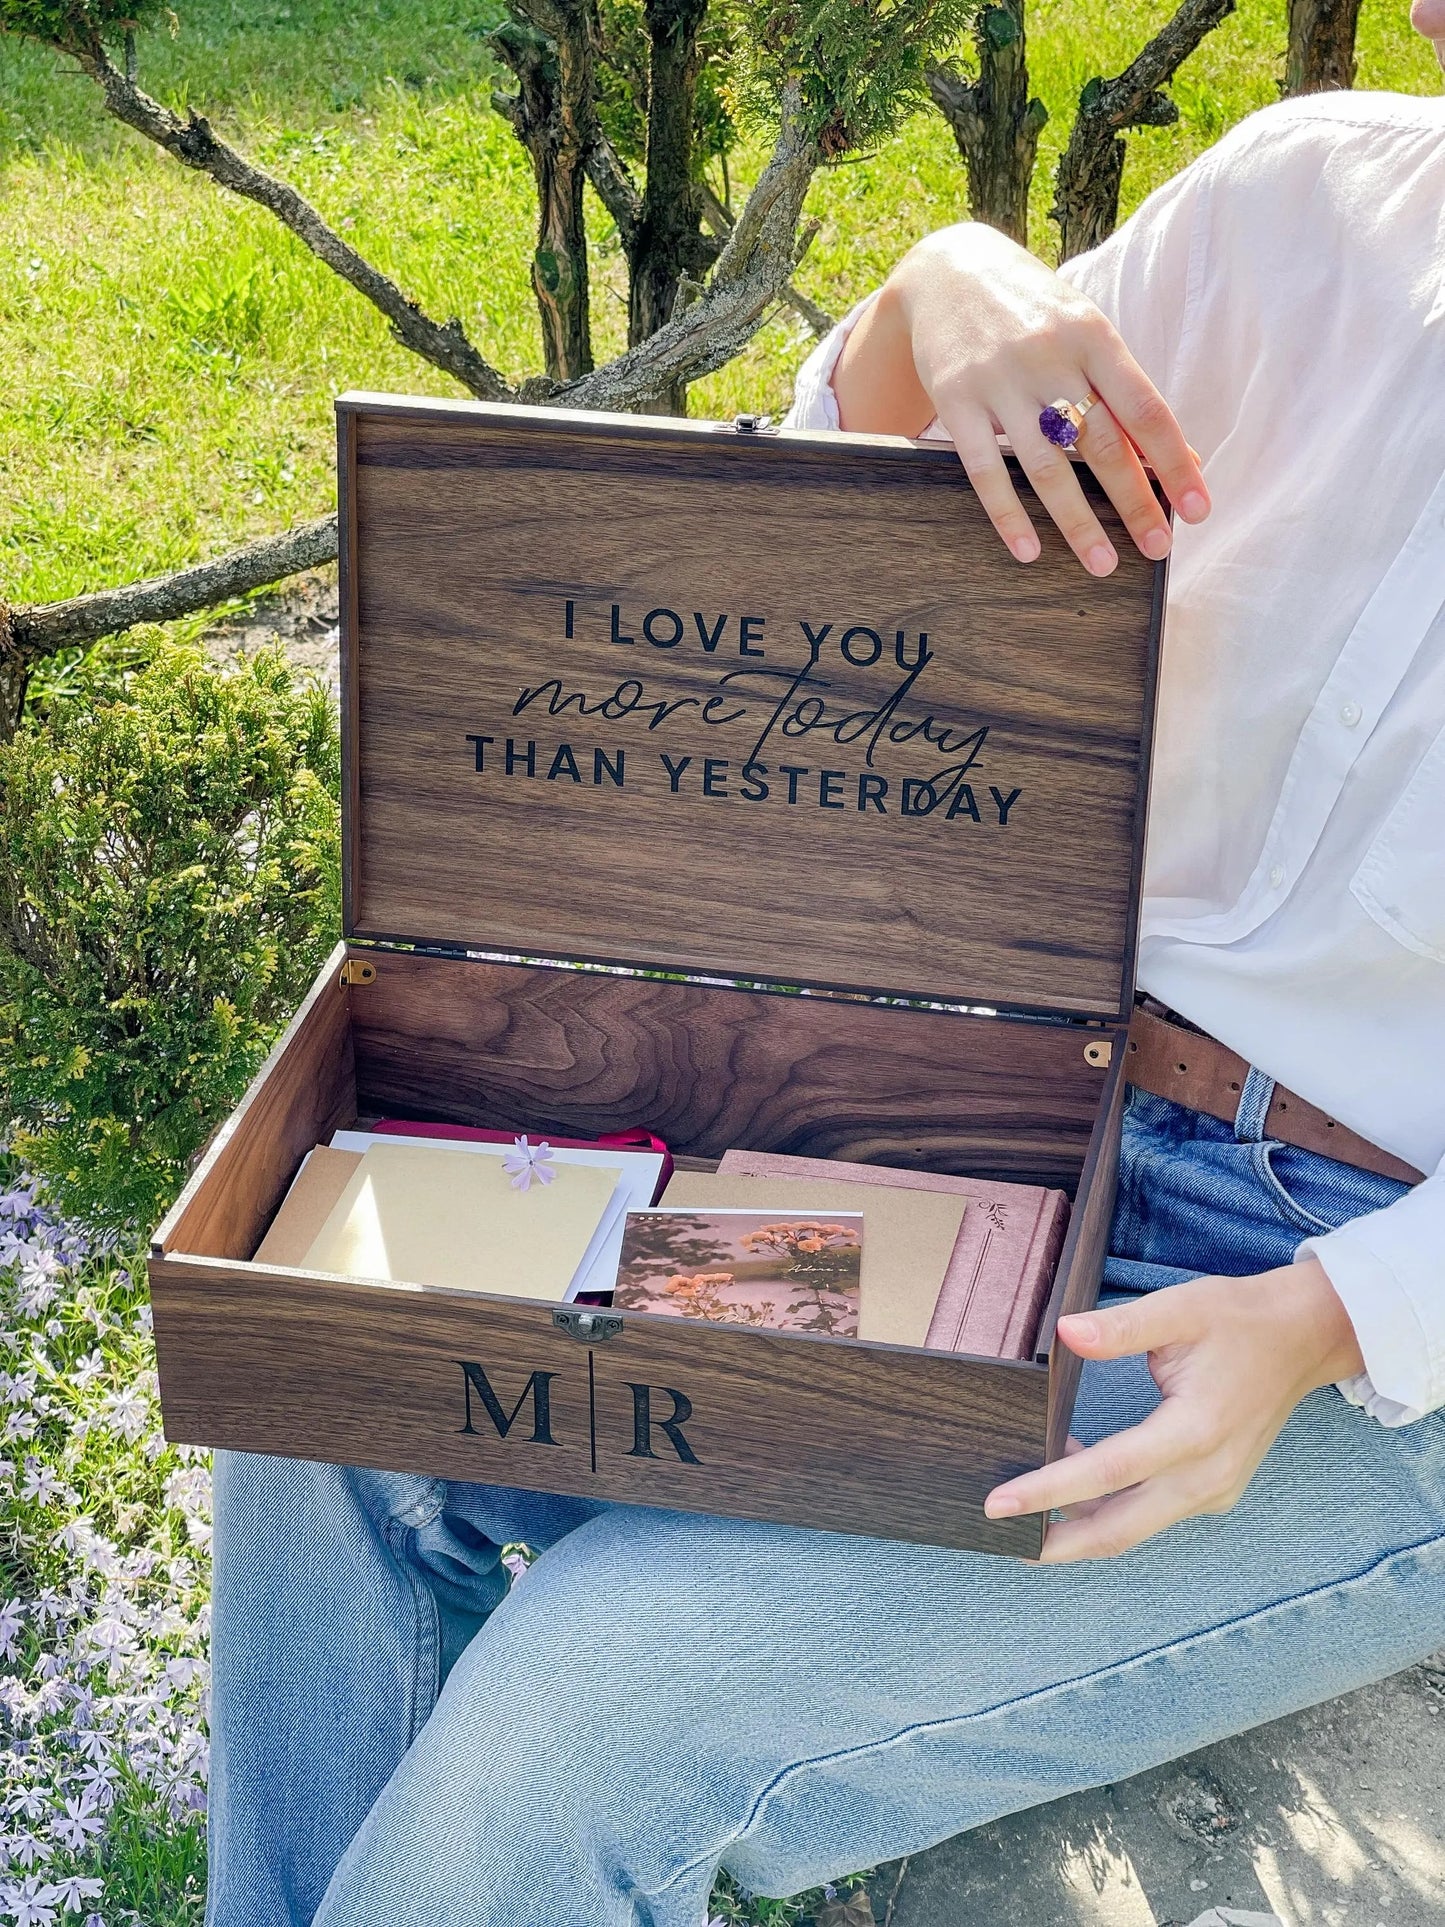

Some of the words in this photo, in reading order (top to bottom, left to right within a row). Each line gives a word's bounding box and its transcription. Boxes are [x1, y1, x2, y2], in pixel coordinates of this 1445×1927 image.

[564, 600, 575, 639] I
[610, 604, 767, 658] LOVE
[799, 620, 930, 670] YOU
[511, 678, 747, 731] more
[464, 734, 626, 788] THAN
[659, 753, 1024, 826] YESTERDAY
[450, 1360, 565, 1446] M
[618, 1381, 706, 1465] R
